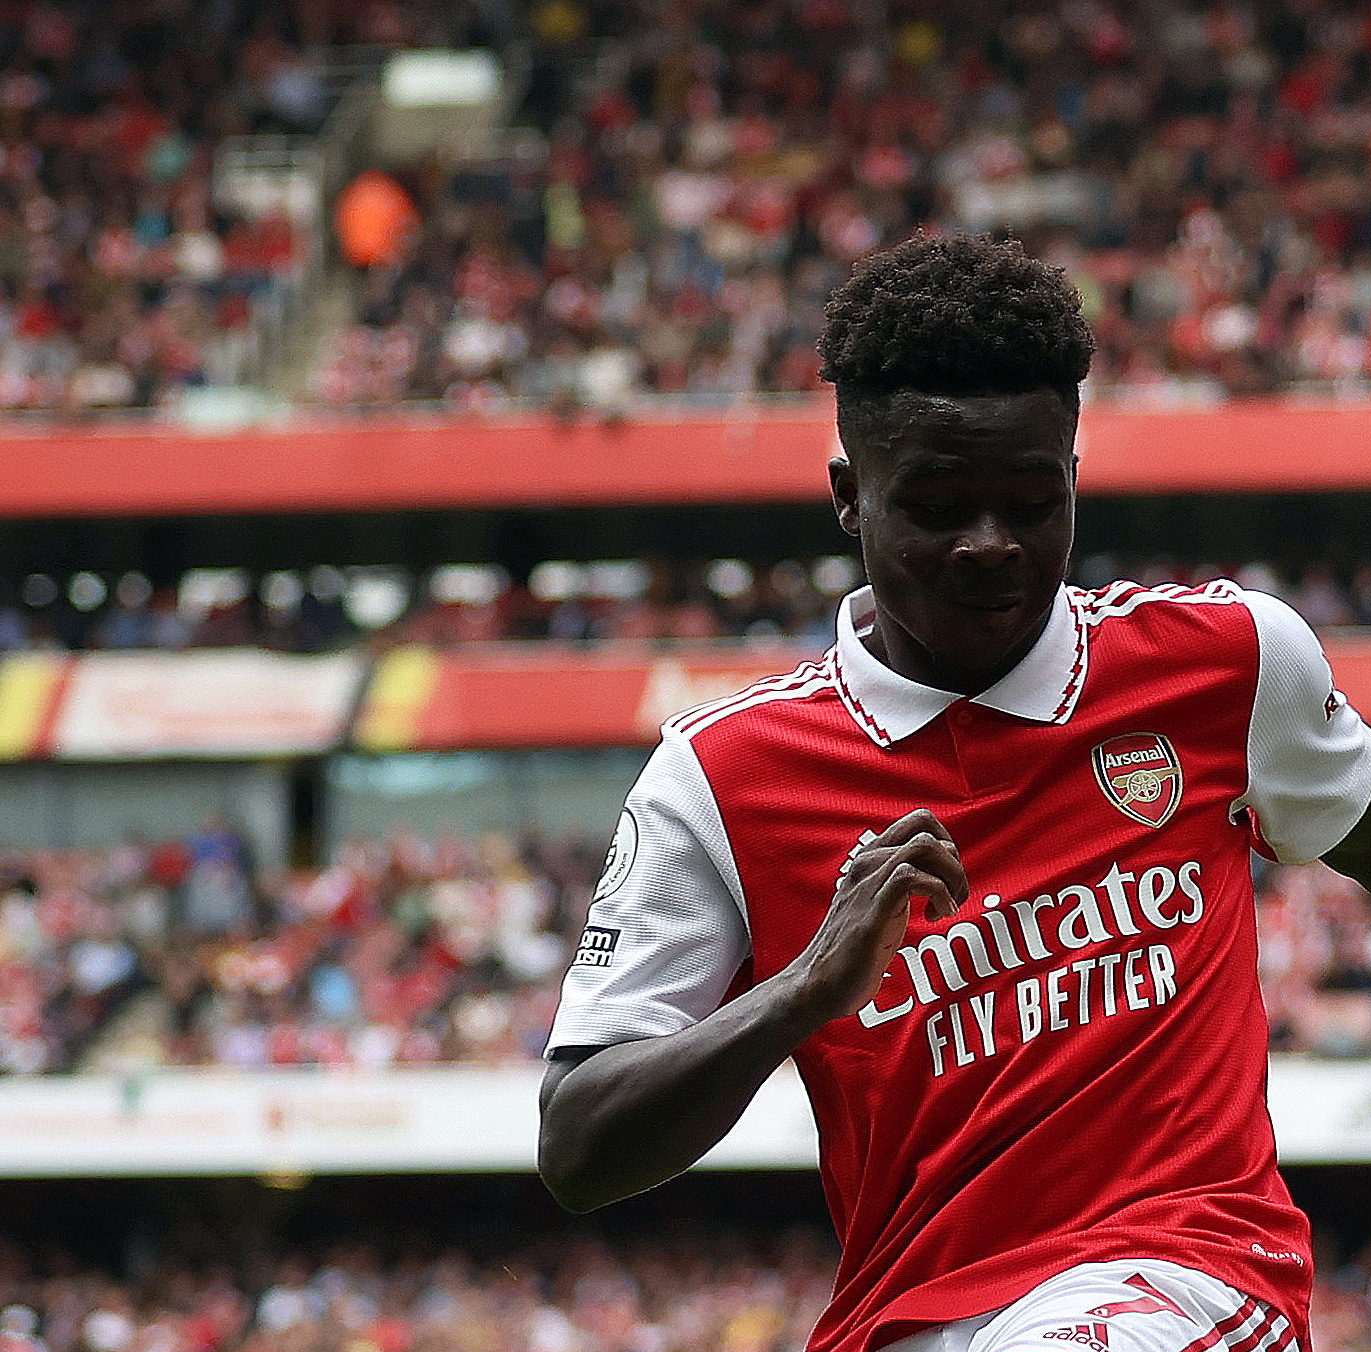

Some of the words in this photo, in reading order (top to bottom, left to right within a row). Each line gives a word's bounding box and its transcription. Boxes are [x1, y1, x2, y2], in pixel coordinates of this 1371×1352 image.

[1105, 744, 1165, 769] Arsenal
[925, 991, 997, 1077] FLY
[1016, 944, 1178, 1044] BETTER
